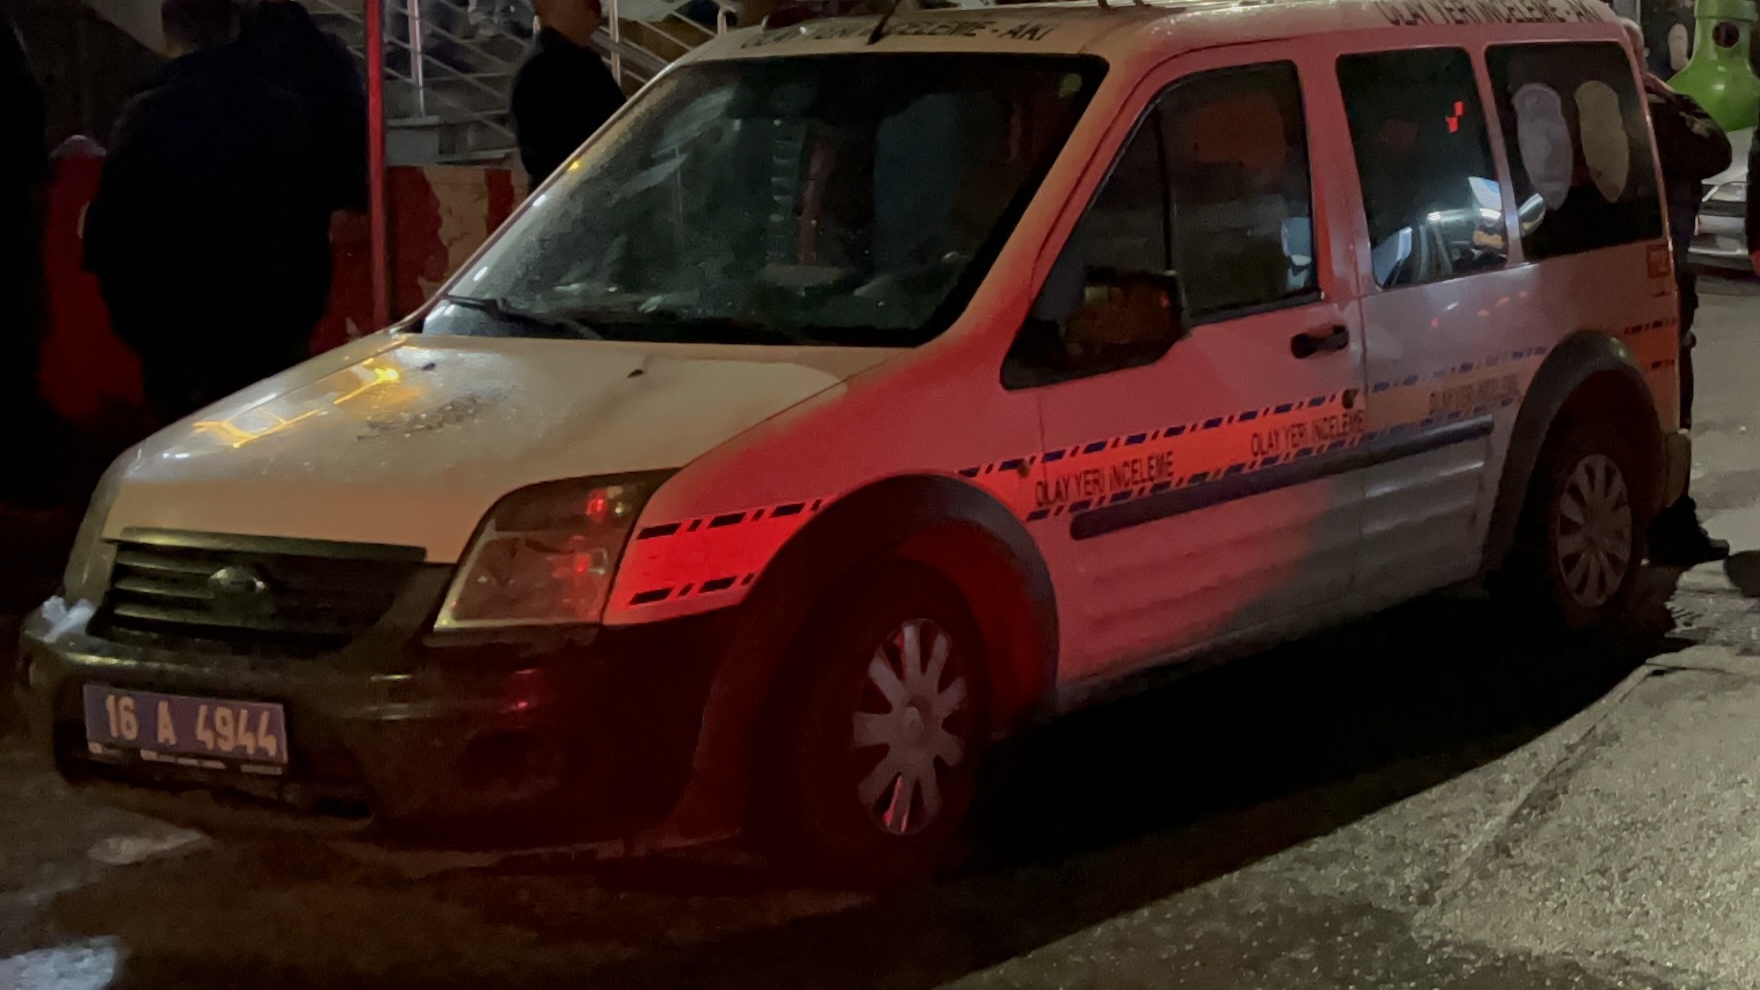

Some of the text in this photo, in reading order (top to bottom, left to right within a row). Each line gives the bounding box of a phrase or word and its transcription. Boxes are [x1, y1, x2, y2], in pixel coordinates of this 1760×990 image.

[105, 694, 278, 758] 16 A 4944
